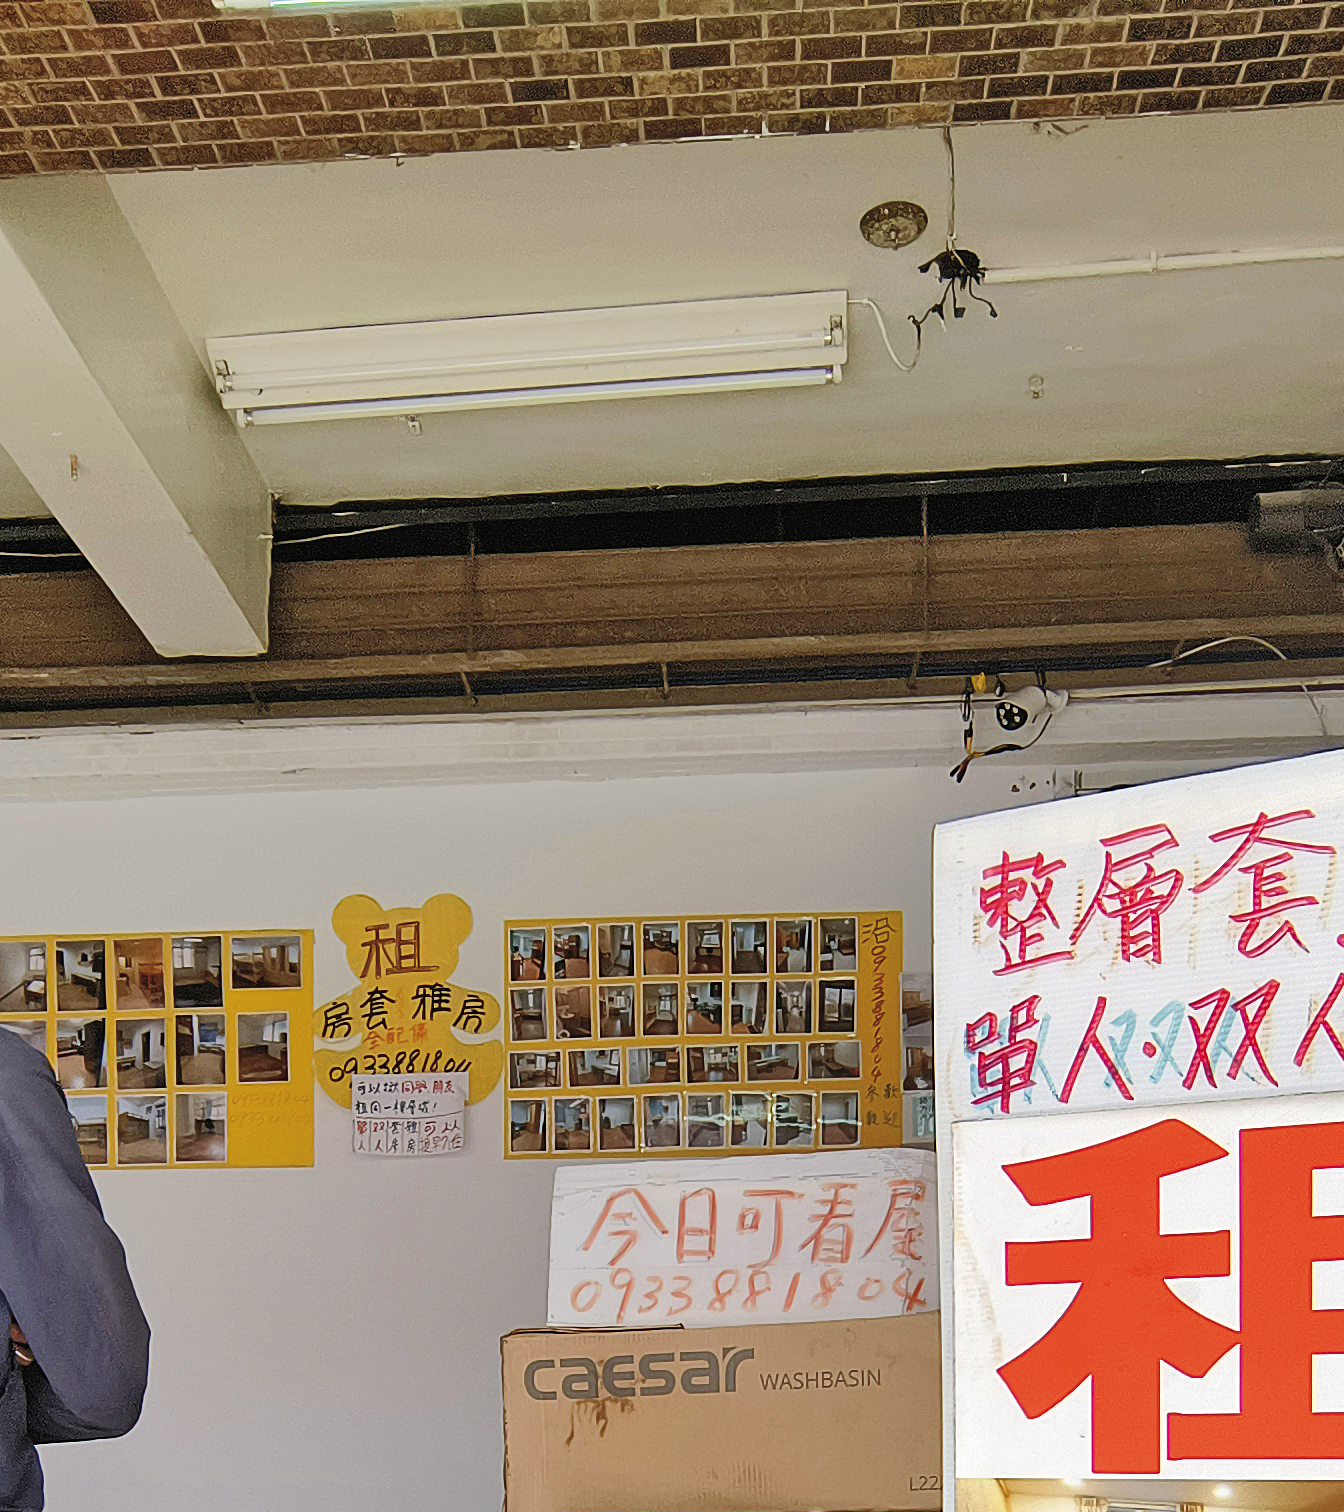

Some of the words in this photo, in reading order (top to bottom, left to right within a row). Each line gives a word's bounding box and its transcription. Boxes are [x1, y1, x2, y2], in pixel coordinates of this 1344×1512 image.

[360, 921, 439, 979] 租
[570, 1267, 927, 1322] 0933881804
[759, 1369, 882, 1391] WASHBASIN
